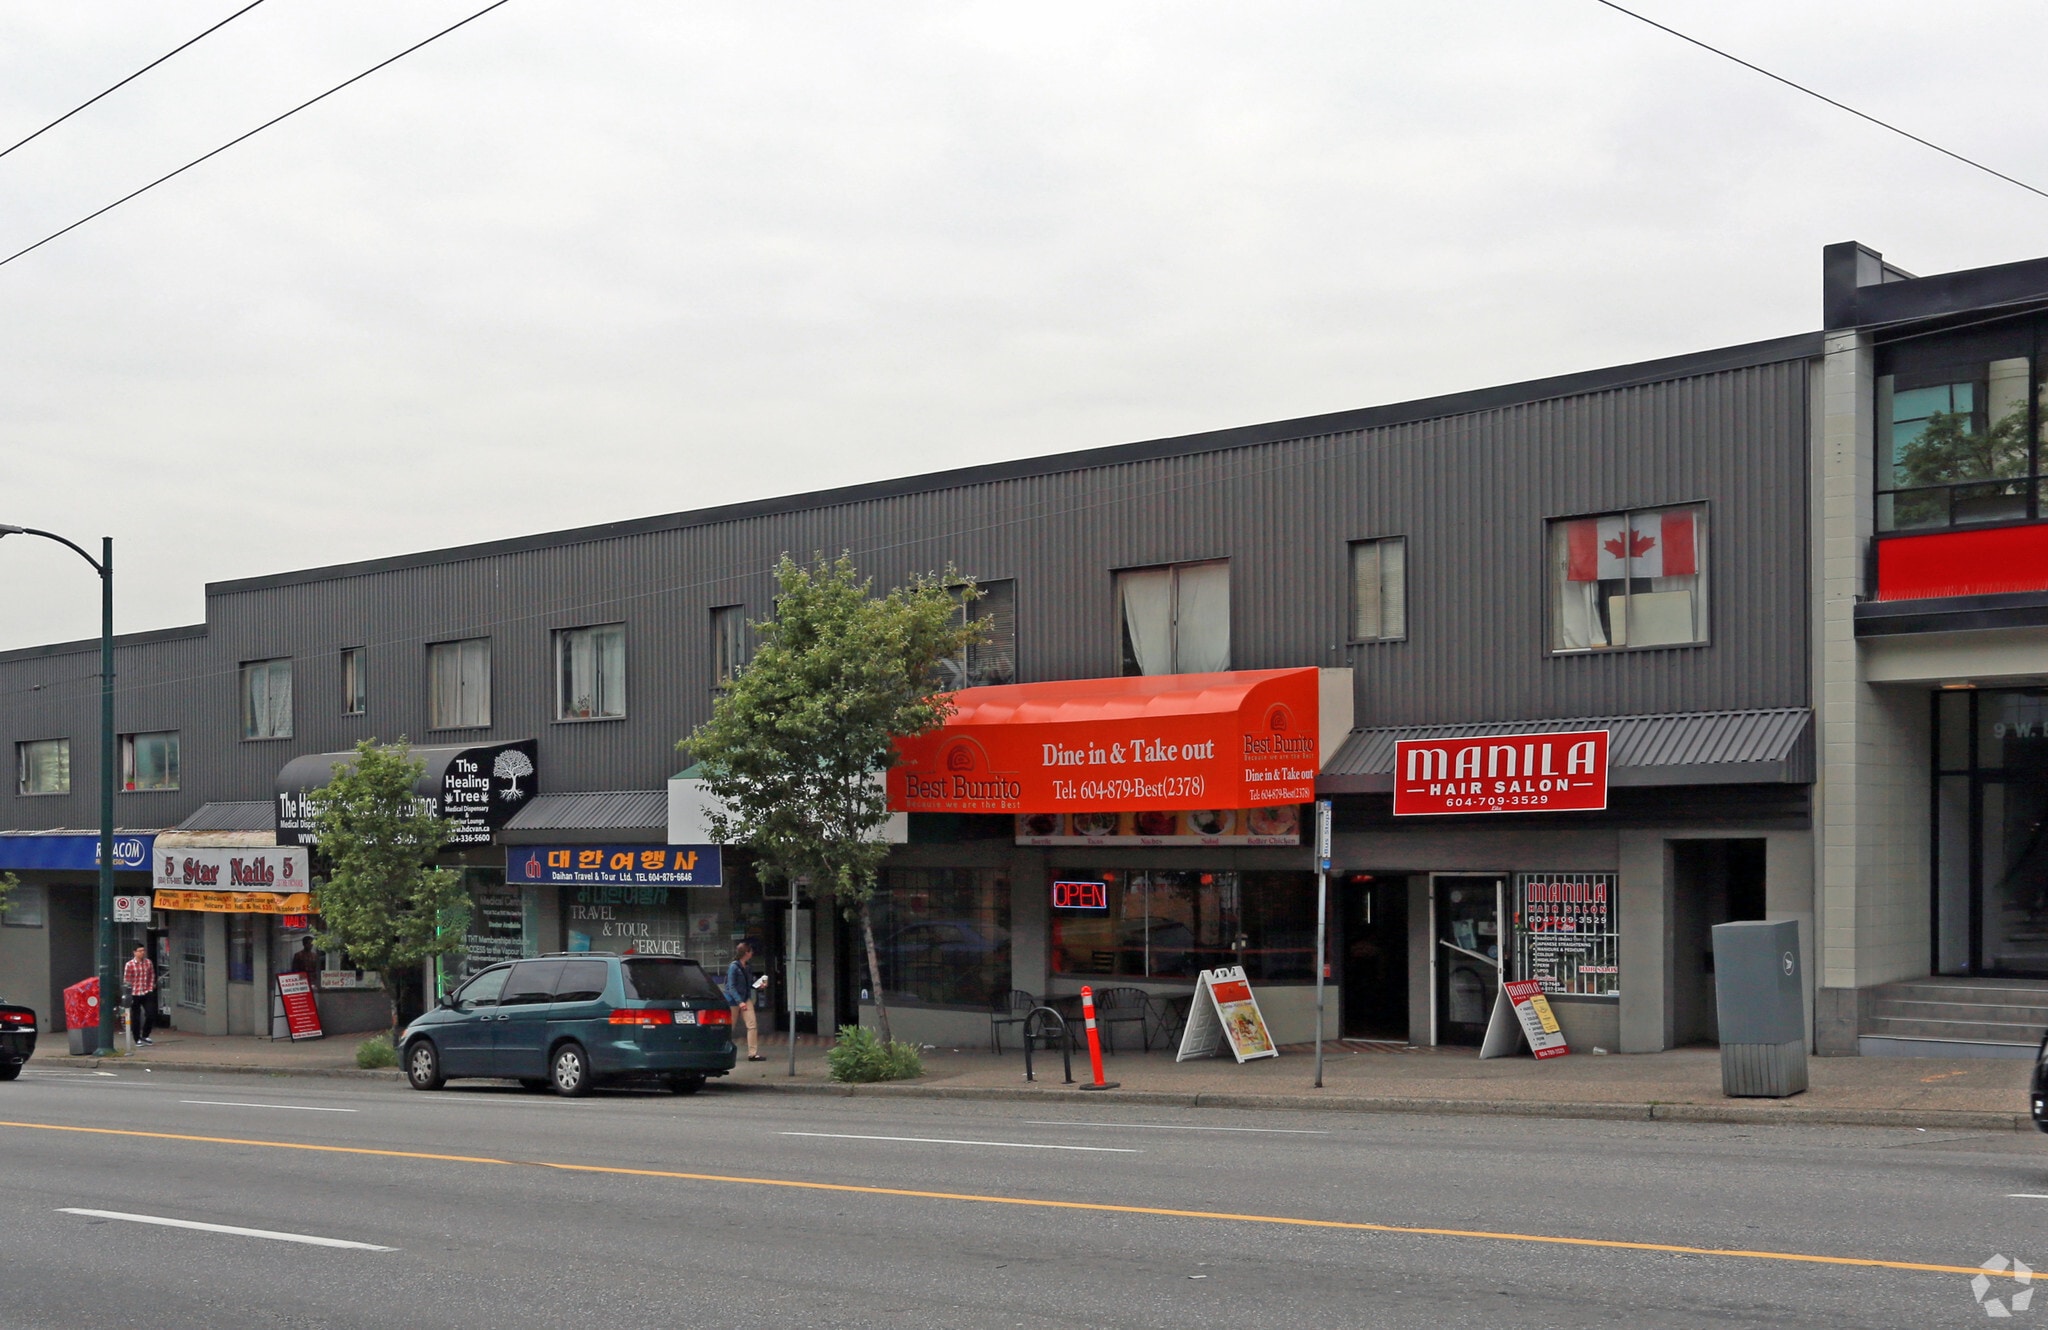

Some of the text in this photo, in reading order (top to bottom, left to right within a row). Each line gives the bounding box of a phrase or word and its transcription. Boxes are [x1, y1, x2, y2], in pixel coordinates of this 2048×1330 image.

[2015, 722, 2036, 737] W.
[1244, 734, 1314, 754] Best Burrito
[1042, 738, 1214, 766] Dine in & Take out
[456, 759, 478, 772] The
[1407, 741, 1595, 780] MANILA
[1245, 767, 1314, 782] Dine in & Take out
[446, 774, 490, 791] Healing
[906, 775, 1020, 800] Best Burrito
[1053, 780, 1076, 799] Tel:
[1430, 779, 1568, 795] HAIR SALON
[453, 790, 480, 802] Tree
[1446, 796, 1548, 807] 604-709-3529
[280, 792, 297, 818] The
[280, 820, 299, 828] Medical
[96, 842, 139, 857] RACOM
[165, 856, 174, 876] 5
[183, 857, 220, 885] Star
[230, 856, 274, 886] Nails
[282, 857, 293, 878] 5
[552, 871, 573, 880] Daihan
[574, 872, 593, 880] Travel
[594, 872, 599, 880] &
[620, 873, 632, 881] Ltd.
[636, 874, 647, 882] TEL
[648, 873, 692, 882] 604-876-6646
[1056, 884, 1105, 906] OPEN
[1528, 883, 1606, 903] MANILA
[571, 905, 616, 920] TRAVEL
[1566, 905, 1607, 913] SALON
[602, 922, 649, 937] & TOUR
[1508, 982, 1540, 996] MANILA
